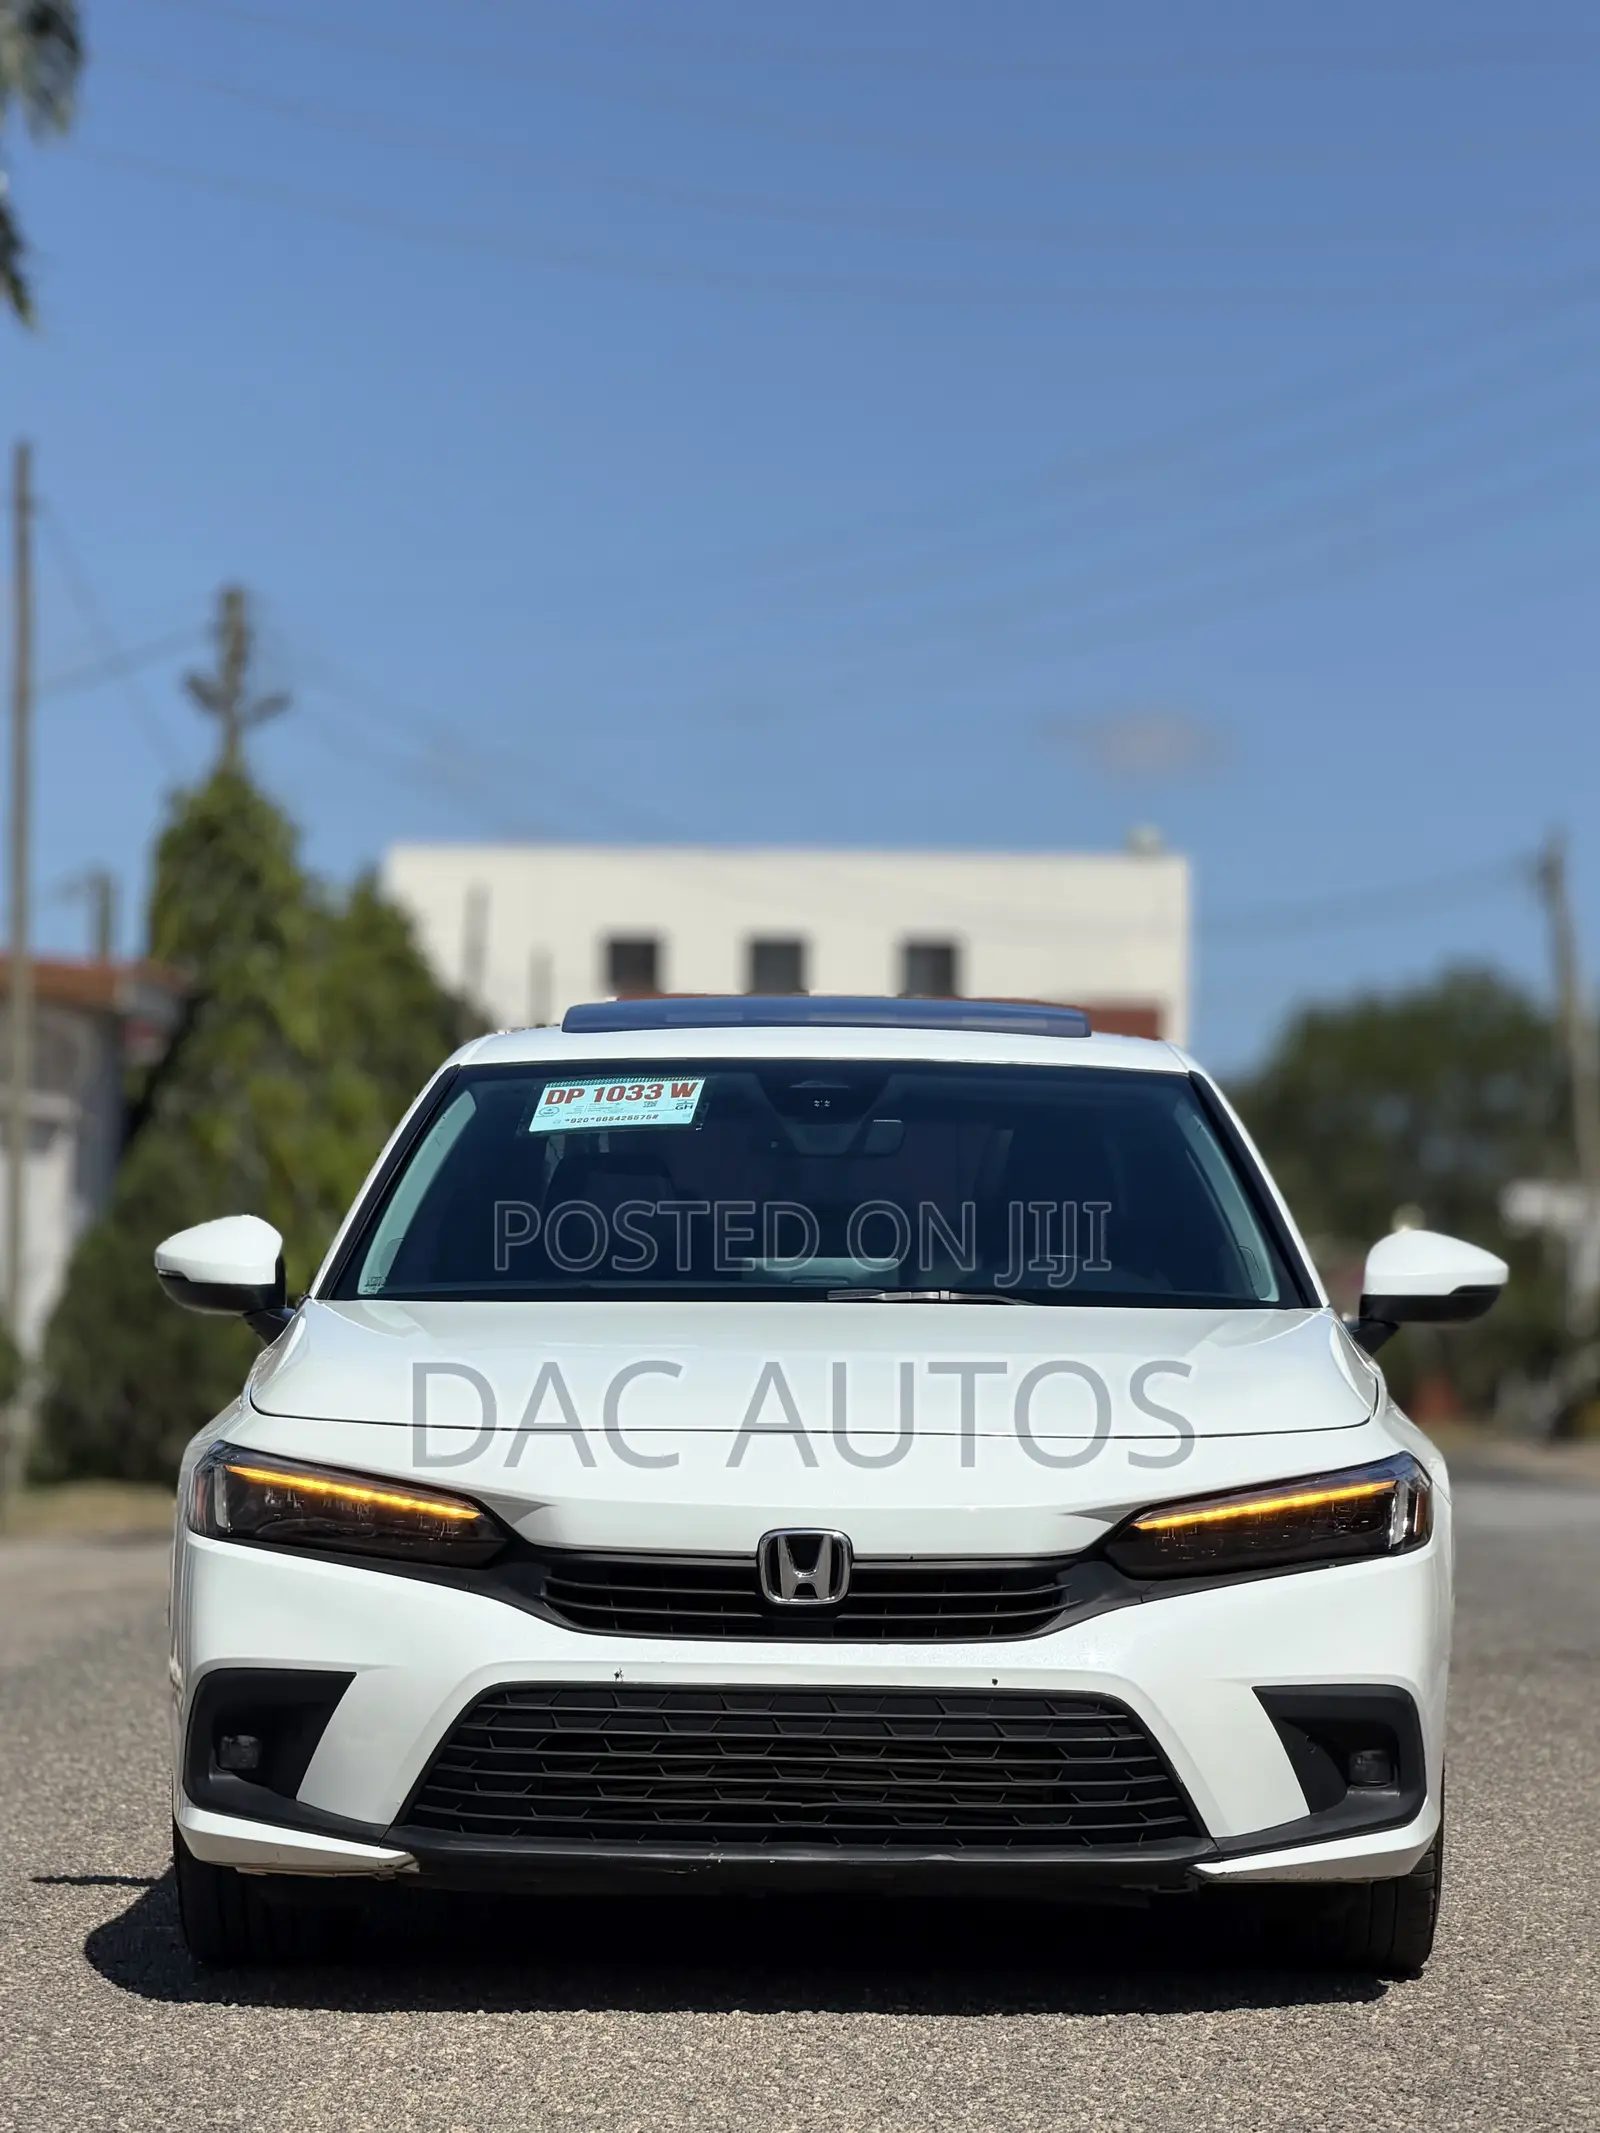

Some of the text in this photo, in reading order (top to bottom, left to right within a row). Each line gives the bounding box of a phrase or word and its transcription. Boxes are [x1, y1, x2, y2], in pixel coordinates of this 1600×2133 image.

[545, 1082, 698, 1105] DP 1033 W
